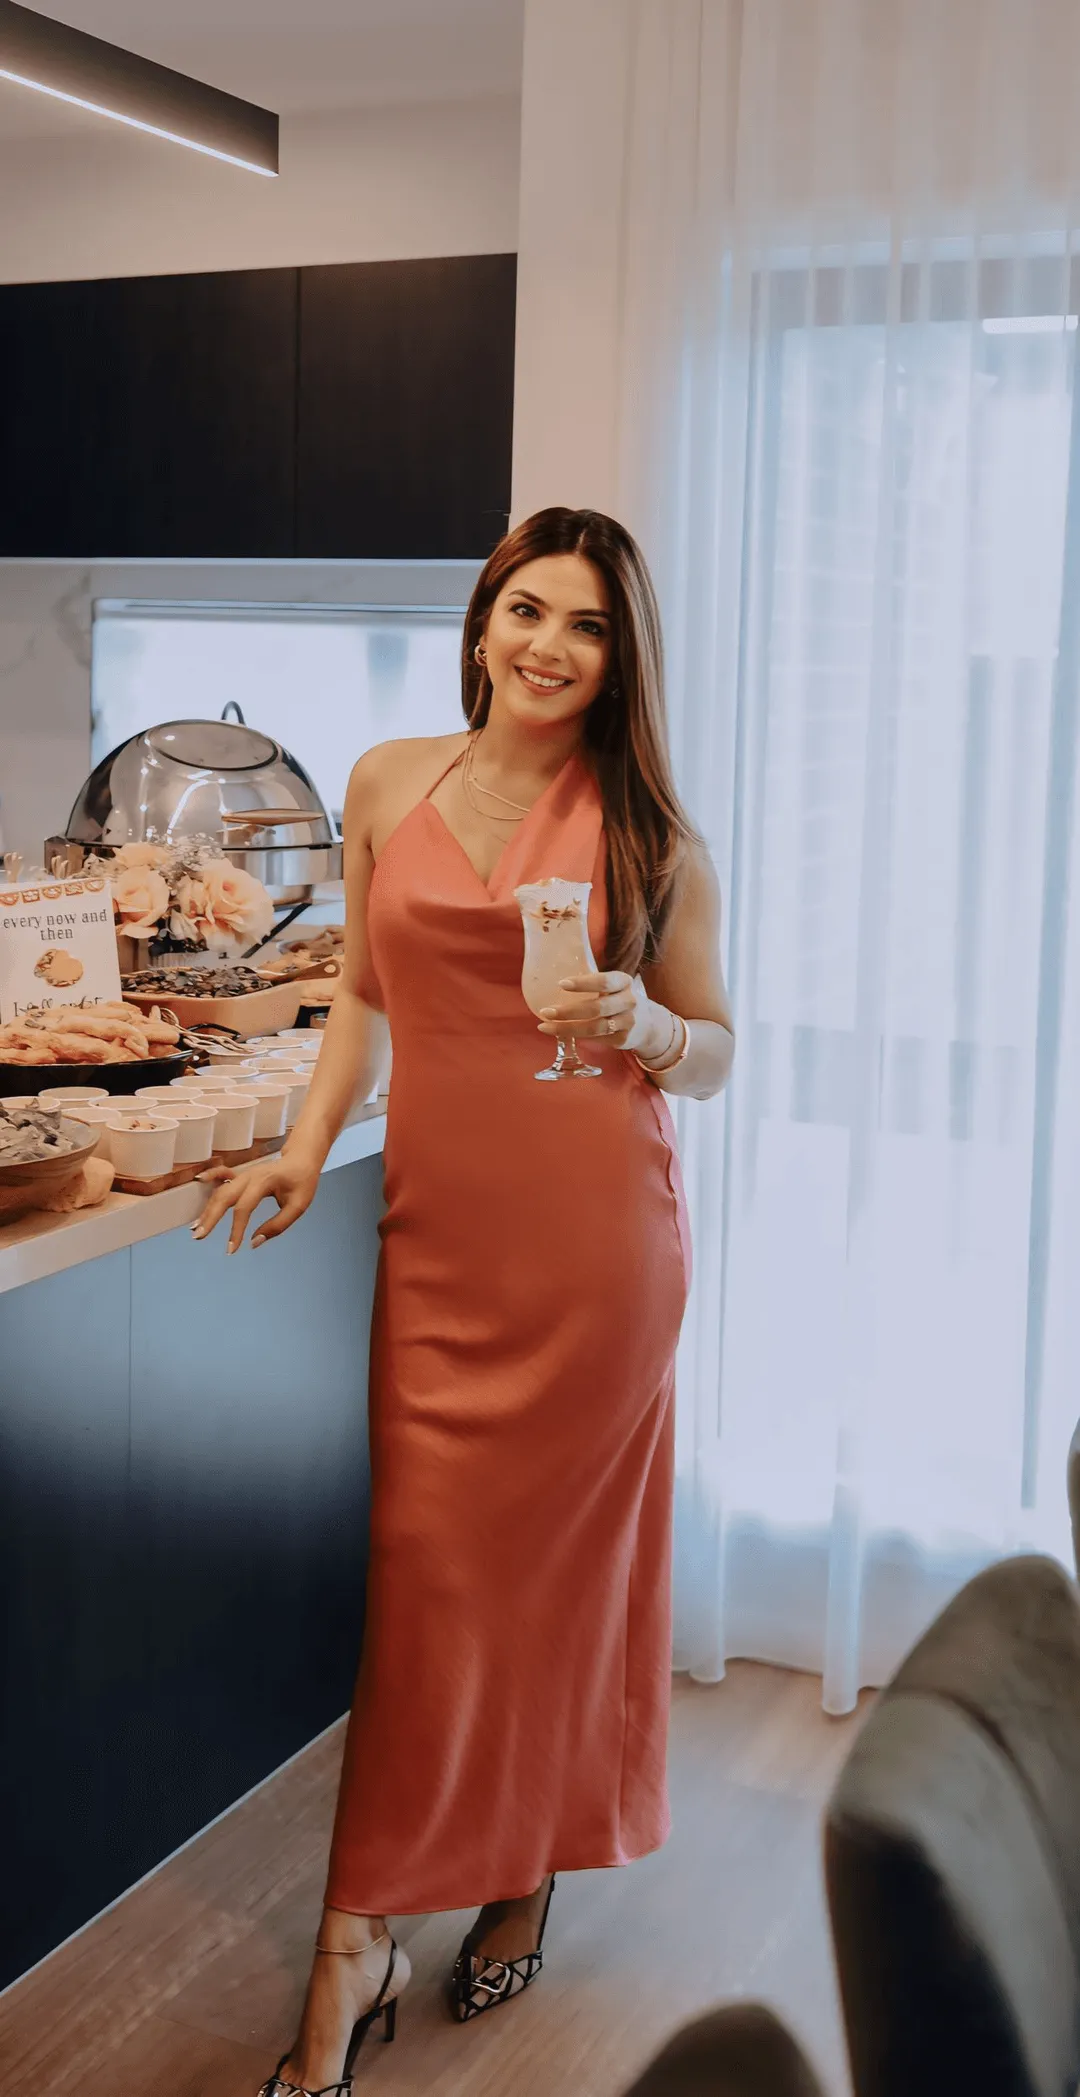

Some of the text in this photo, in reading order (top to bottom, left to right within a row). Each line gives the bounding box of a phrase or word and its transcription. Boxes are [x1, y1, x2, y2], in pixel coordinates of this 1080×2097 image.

[3, 909, 107, 929] every now and
[40, 927, 73, 941] then
